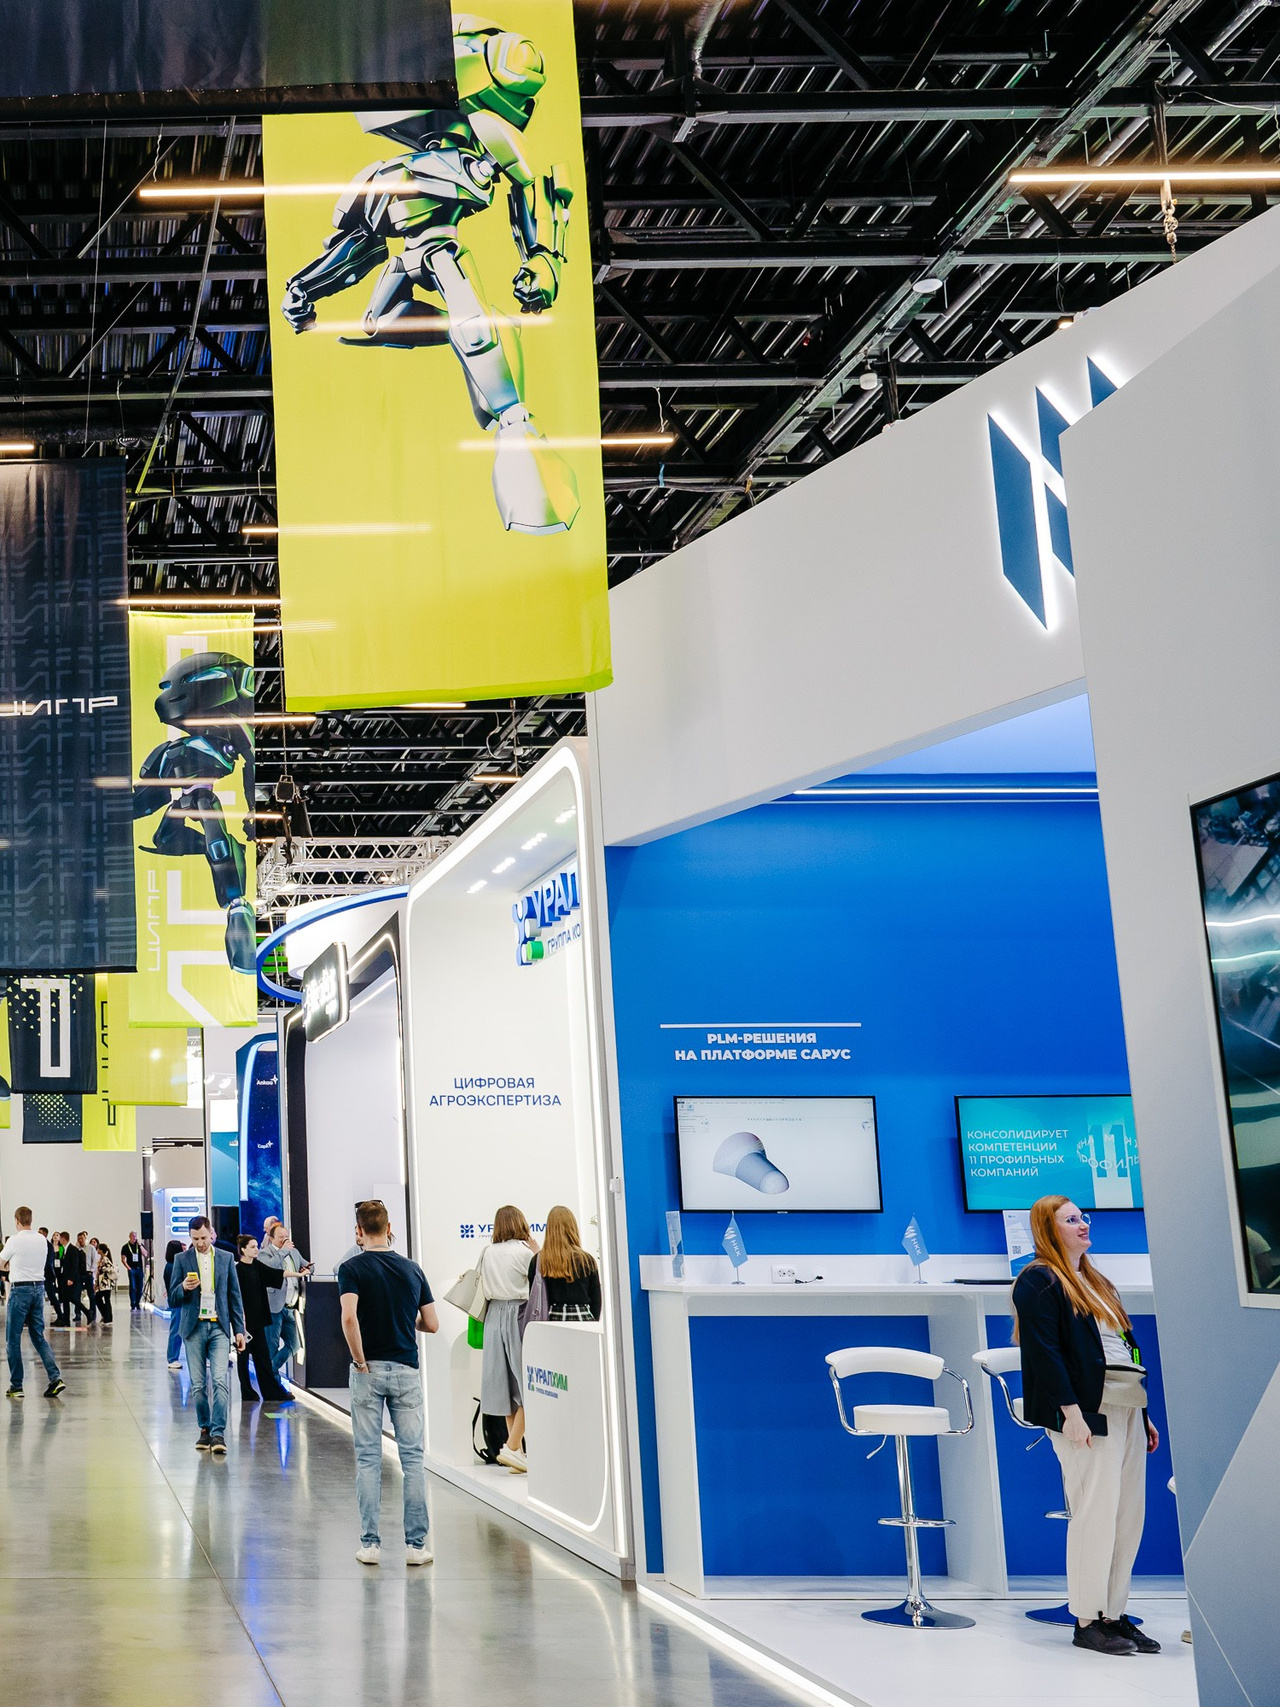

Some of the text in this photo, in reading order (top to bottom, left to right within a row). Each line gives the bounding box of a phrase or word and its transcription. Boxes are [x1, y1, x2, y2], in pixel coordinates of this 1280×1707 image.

[707, 1032, 817, 1044] PLM-РЕШЕНИЯ
[675, 1048, 851, 1061] НА ПЛАТФОРМЕ САРУС
[453, 1077, 535, 1090] ЦИФРОВАЯ
[429, 1095, 562, 1106] АГРОЭКСПЕРТИЗА
[967, 1129, 1068, 1140] КОНСОЛИДИРУЕТ
[968, 1142, 1057, 1153] КОМПЕТЕНЦИИ
[969, 1155, 1065, 1165] 11 ПРОФИЛЬНЫХ
[971, 1167, 1039, 1177] КОМПАНИЙ
[534, 1366, 569, 1391] УРАЛХИМ
